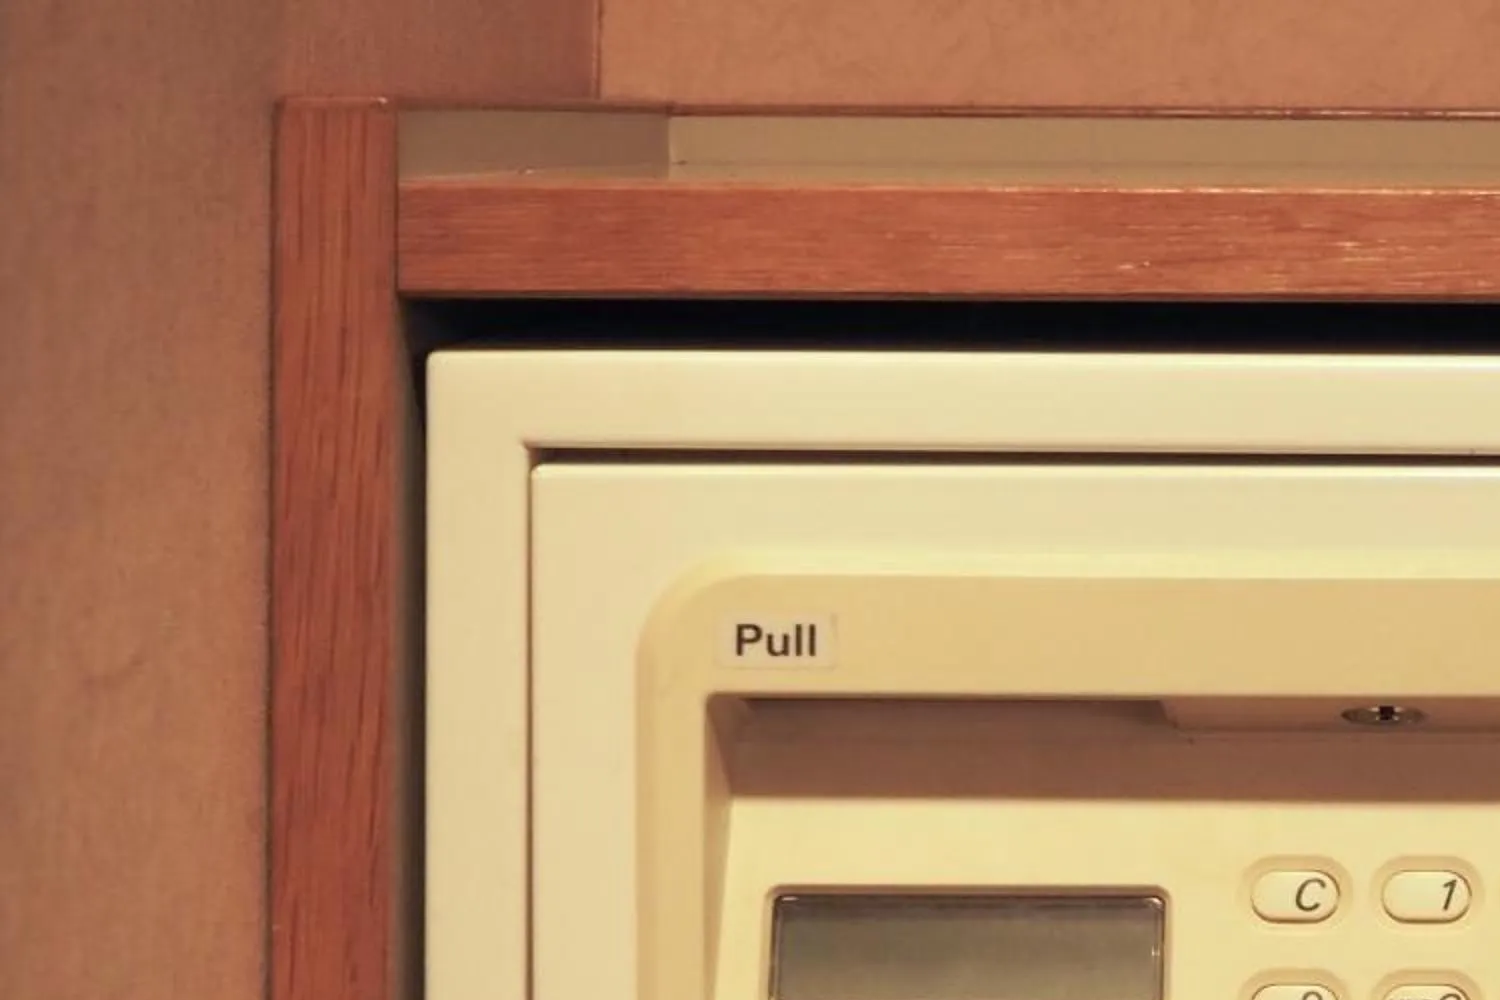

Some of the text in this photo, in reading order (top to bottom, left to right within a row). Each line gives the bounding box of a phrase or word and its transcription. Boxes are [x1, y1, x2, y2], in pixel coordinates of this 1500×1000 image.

[736, 624, 816, 657] Pull
[1294, 879, 1326, 911] C
[1440, 880, 1458, 910] 1
